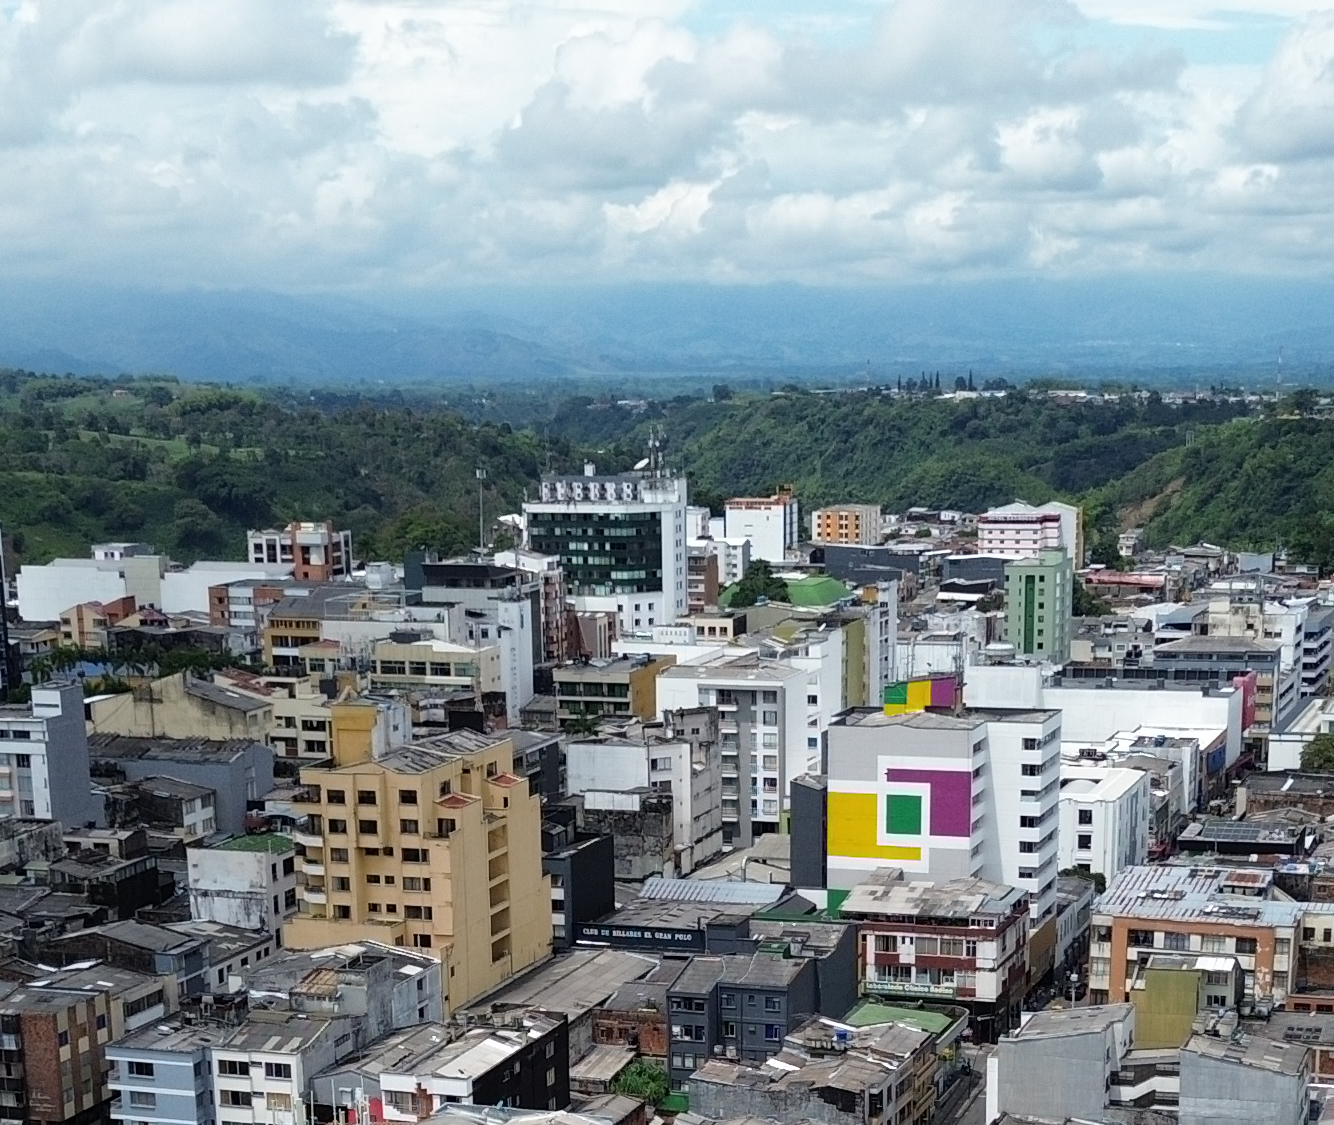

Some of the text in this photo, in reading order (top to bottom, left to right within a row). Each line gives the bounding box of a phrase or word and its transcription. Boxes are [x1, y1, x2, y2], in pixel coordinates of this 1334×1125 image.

[582, 928, 598, 936] CLUB
[612, 930, 641, 938] BILLARES
[644, 931, 652, 939] EL
[654, 932, 672, 940] GRAN
[674, 933, 692, 941] POLO
